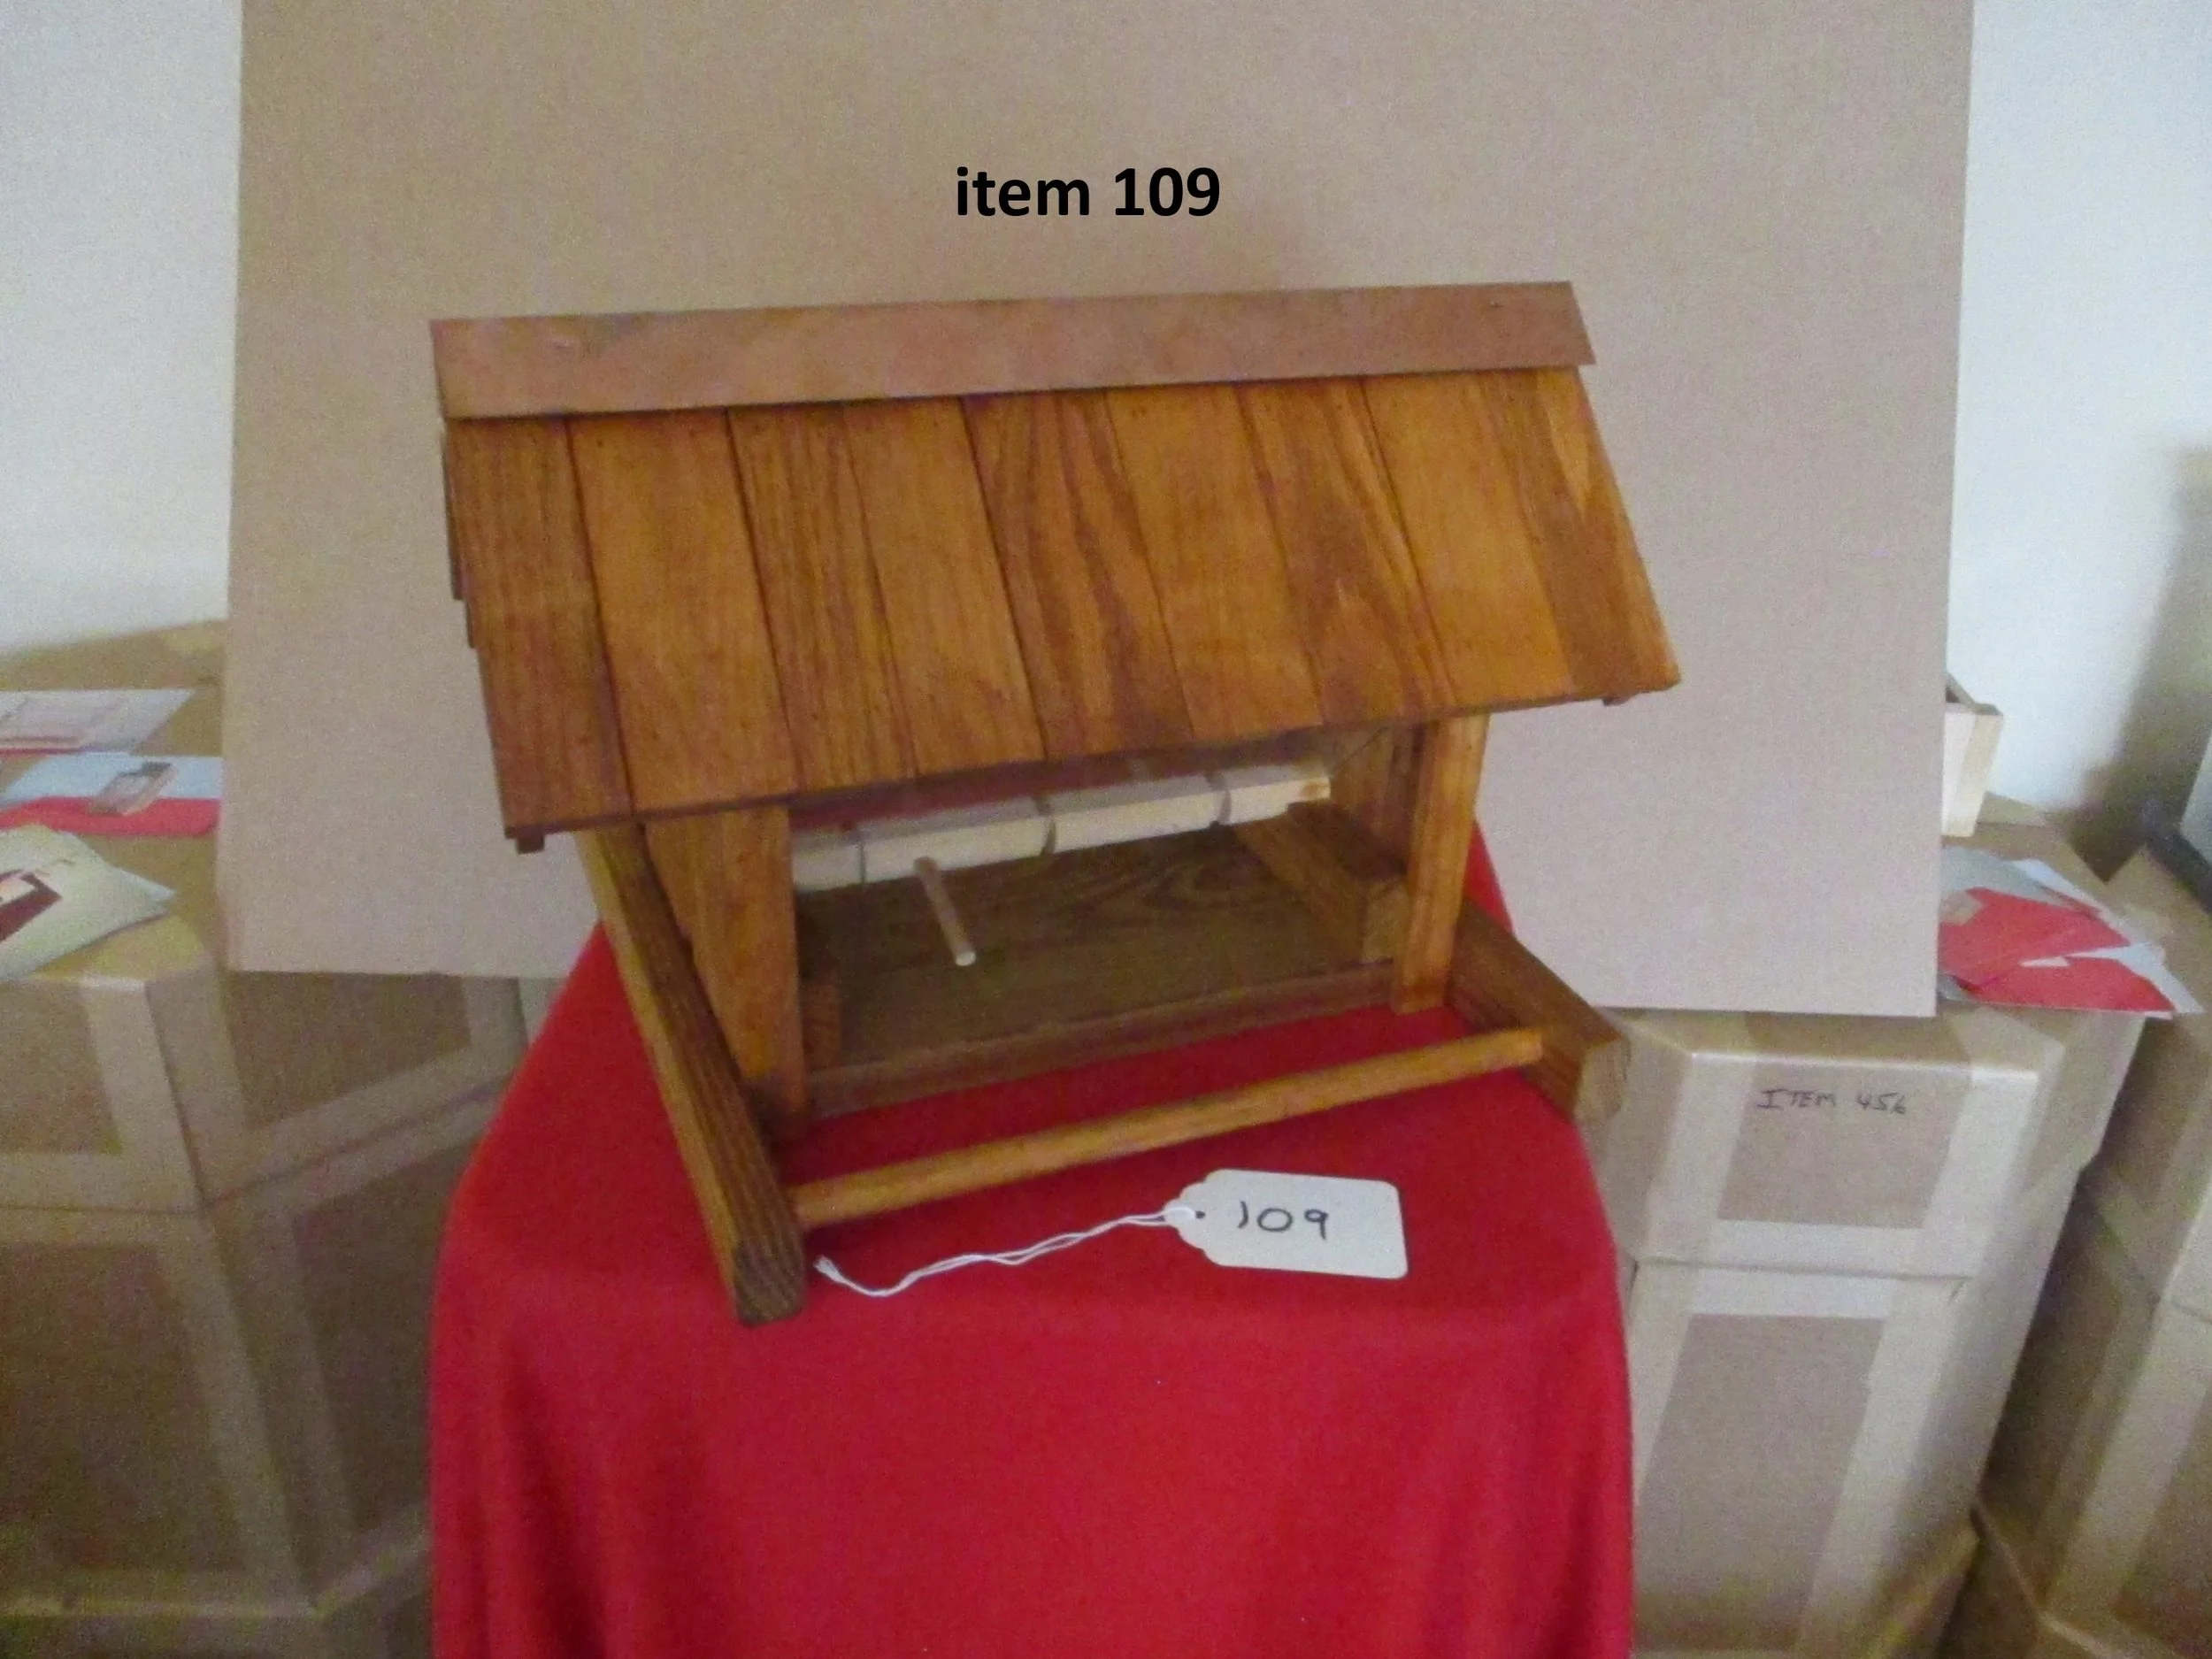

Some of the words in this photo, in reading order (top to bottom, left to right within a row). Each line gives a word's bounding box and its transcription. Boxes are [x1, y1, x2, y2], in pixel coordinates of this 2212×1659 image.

[1757, 1087, 1836, 1110] ITEM
[1856, 1092, 1907, 1115] 456
[1237, 1200, 1329, 1240] 109
